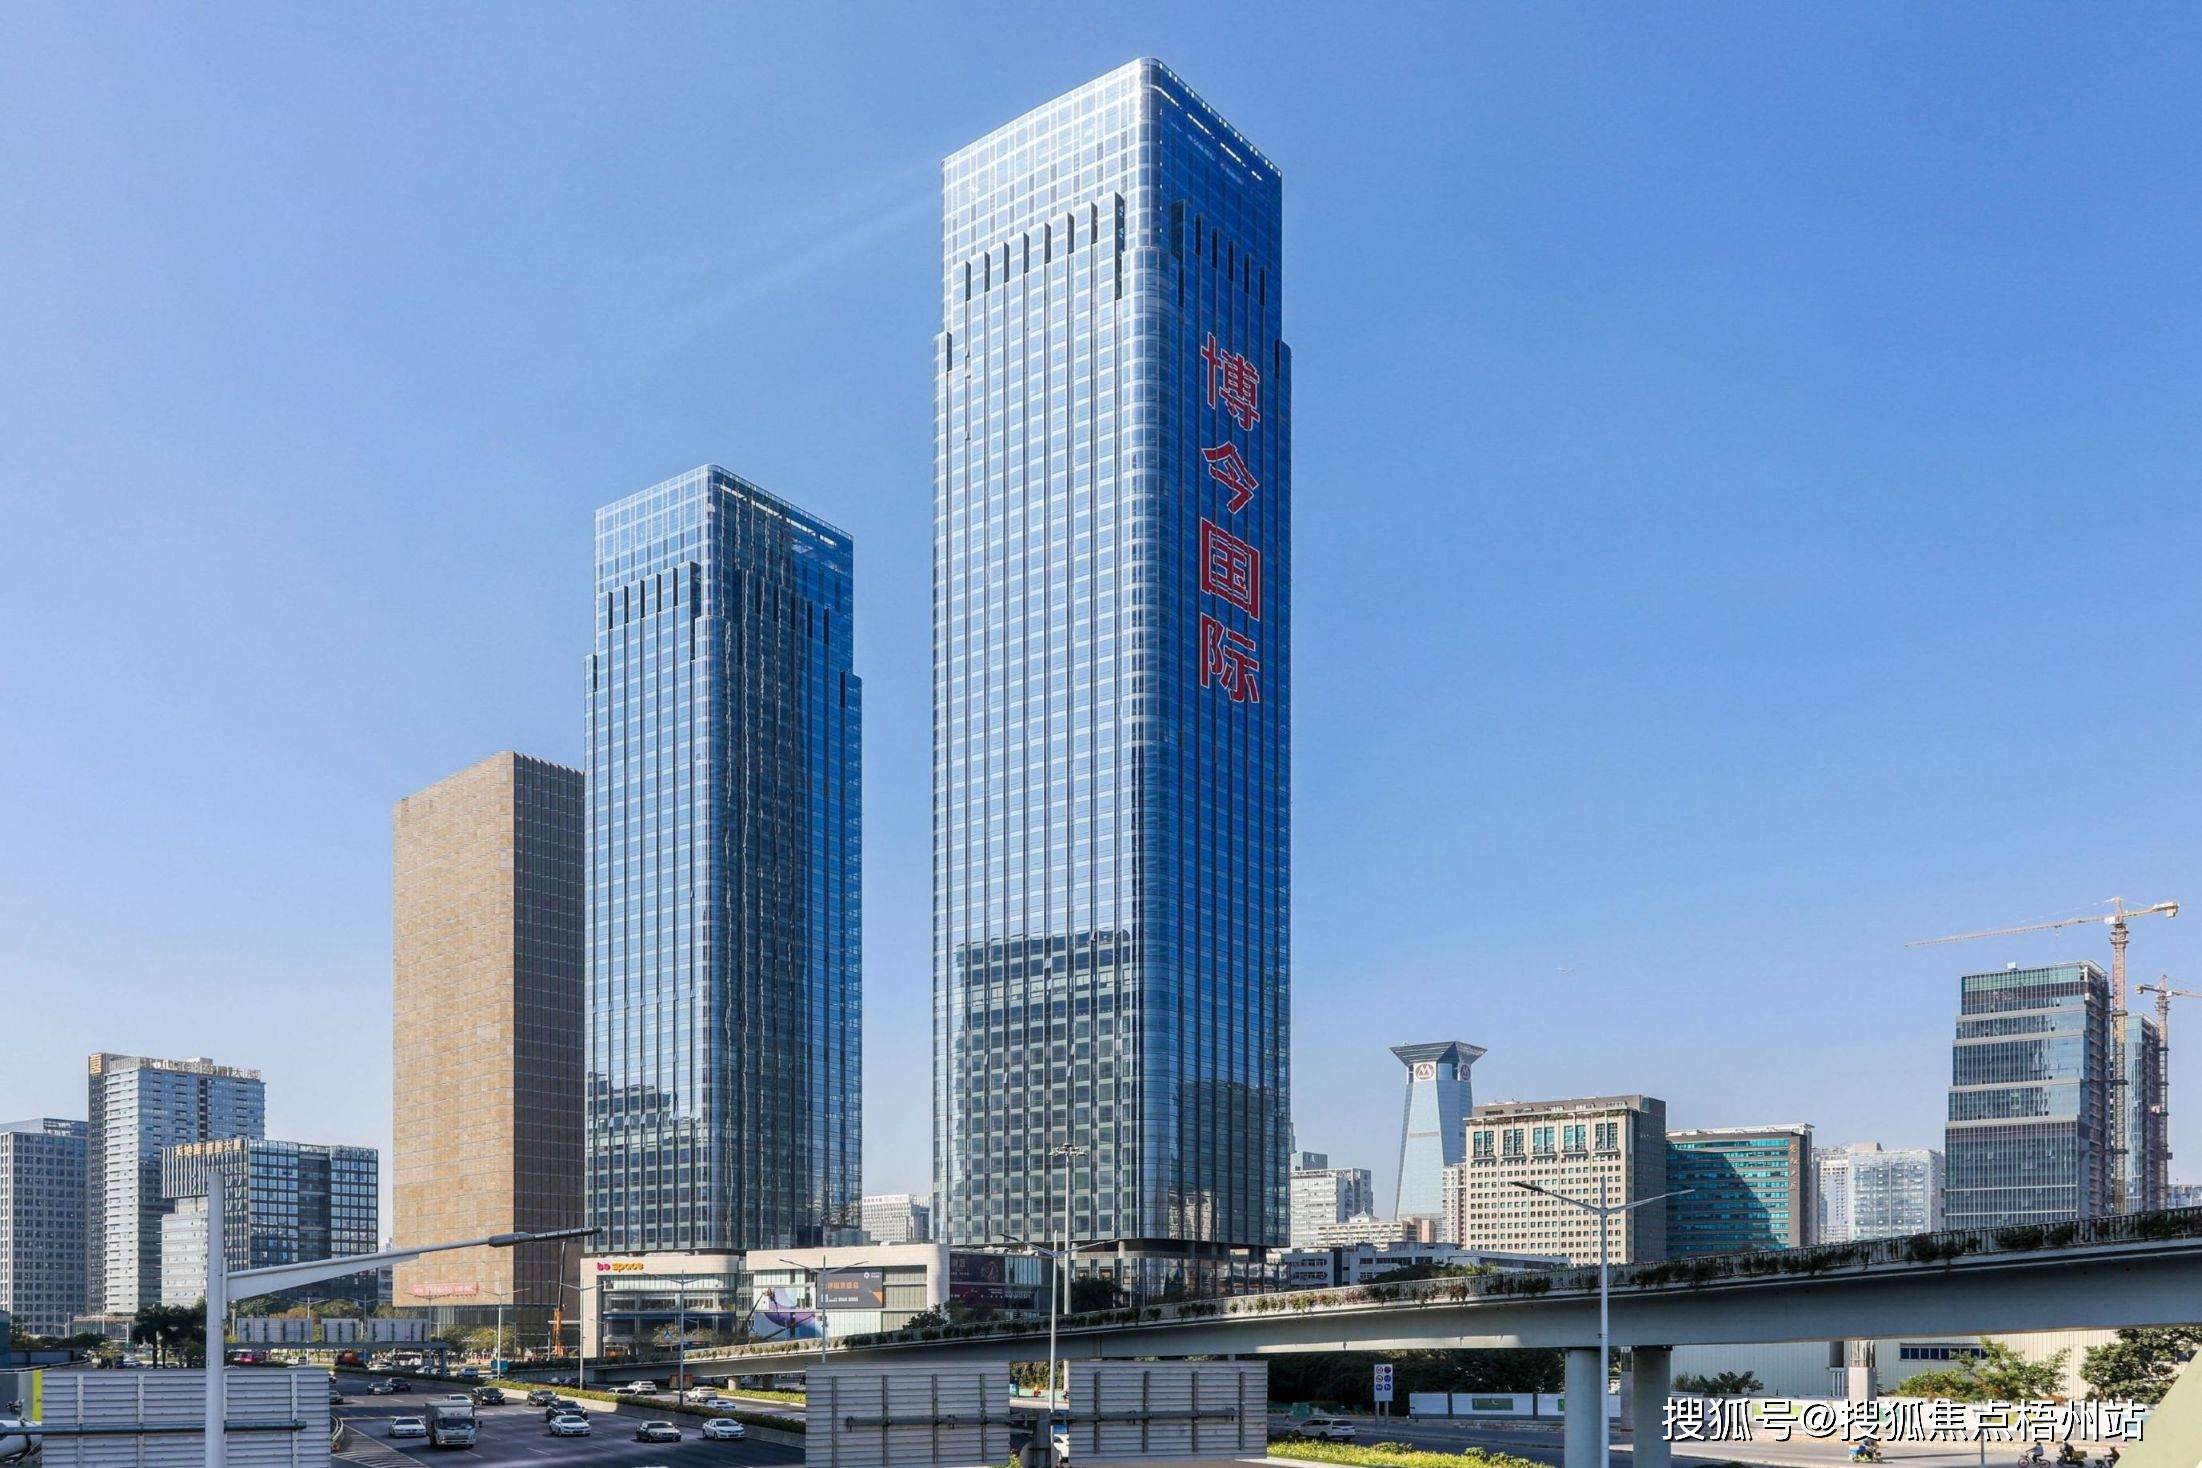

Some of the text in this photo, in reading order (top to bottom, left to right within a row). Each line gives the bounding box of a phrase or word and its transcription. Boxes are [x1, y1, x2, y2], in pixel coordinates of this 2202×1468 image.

[1201, 332, 1261, 704] 博今国际
[597, 1262, 644, 1272] be space
